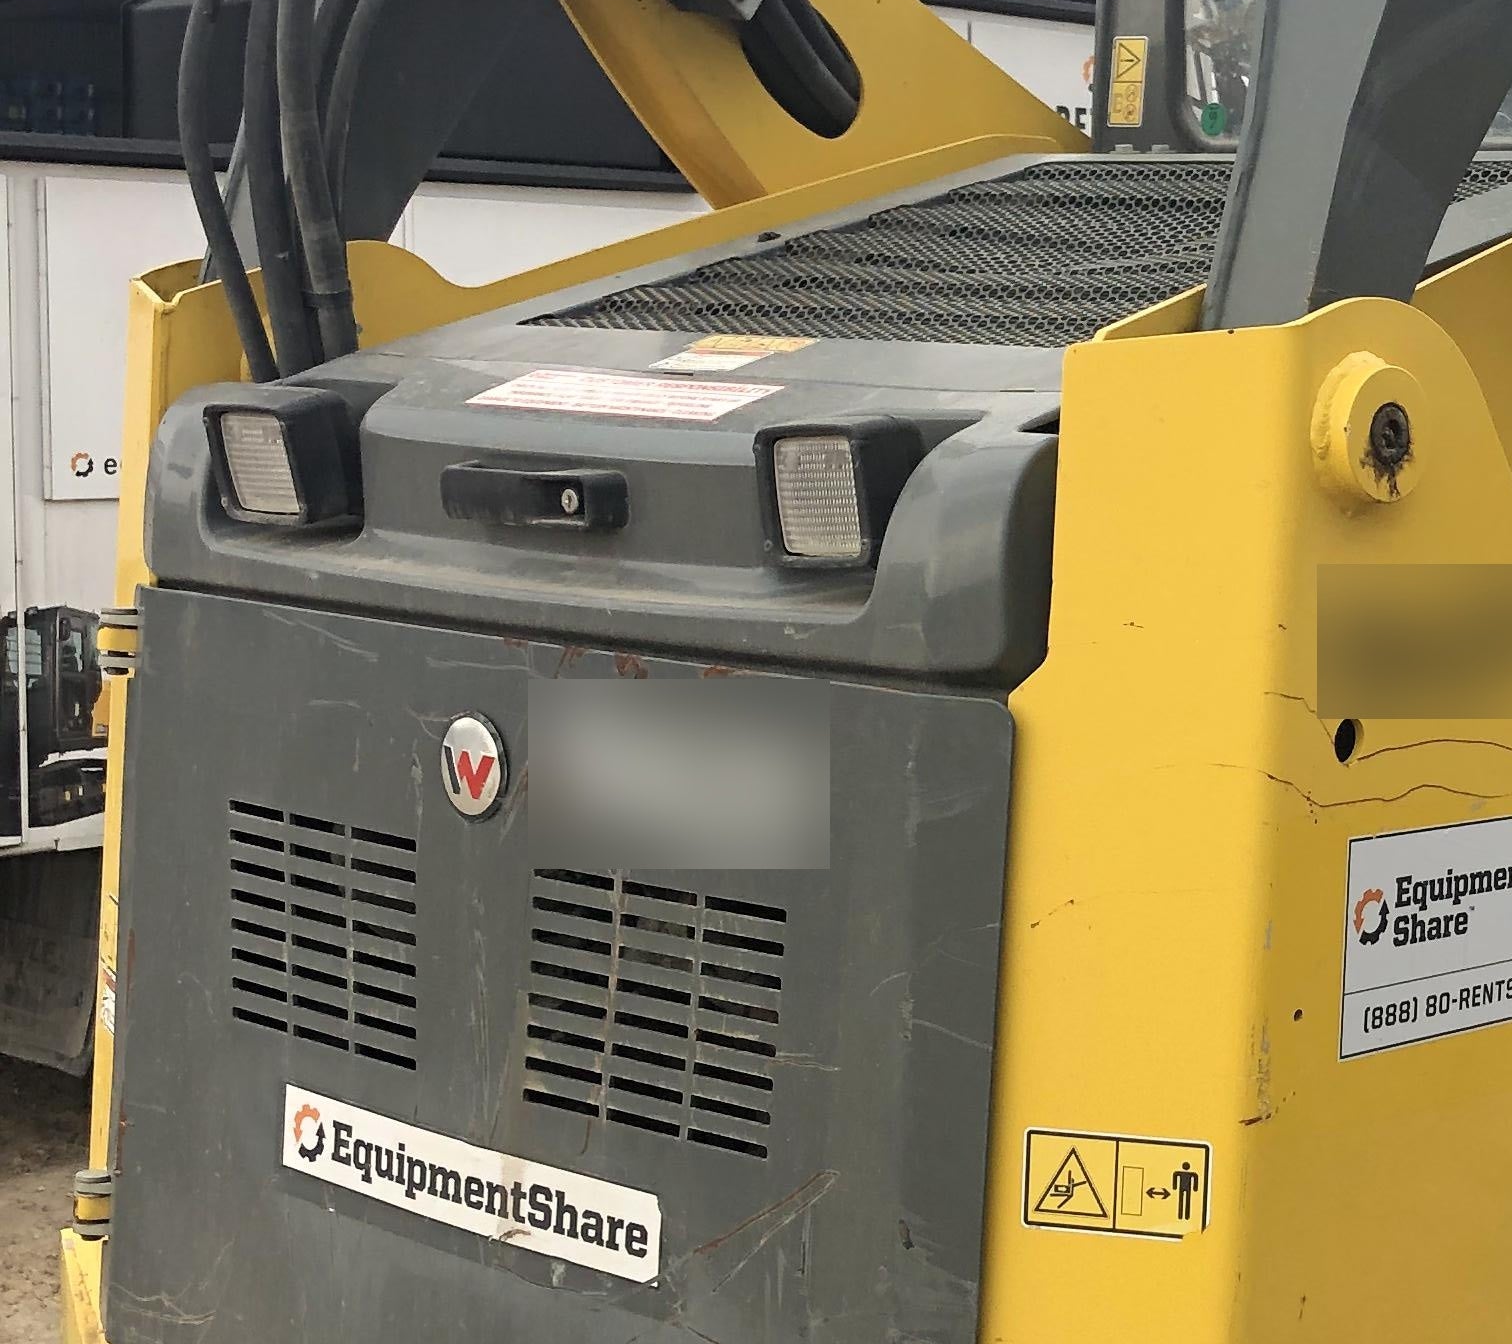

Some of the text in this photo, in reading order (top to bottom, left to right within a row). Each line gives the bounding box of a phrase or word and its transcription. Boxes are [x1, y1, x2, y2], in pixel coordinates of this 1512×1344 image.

[1392, 908, 1468, 947] Share
[1363, 998, 1419, 1034] (888)
[331, 1119, 649, 1259] EquipmentShare
